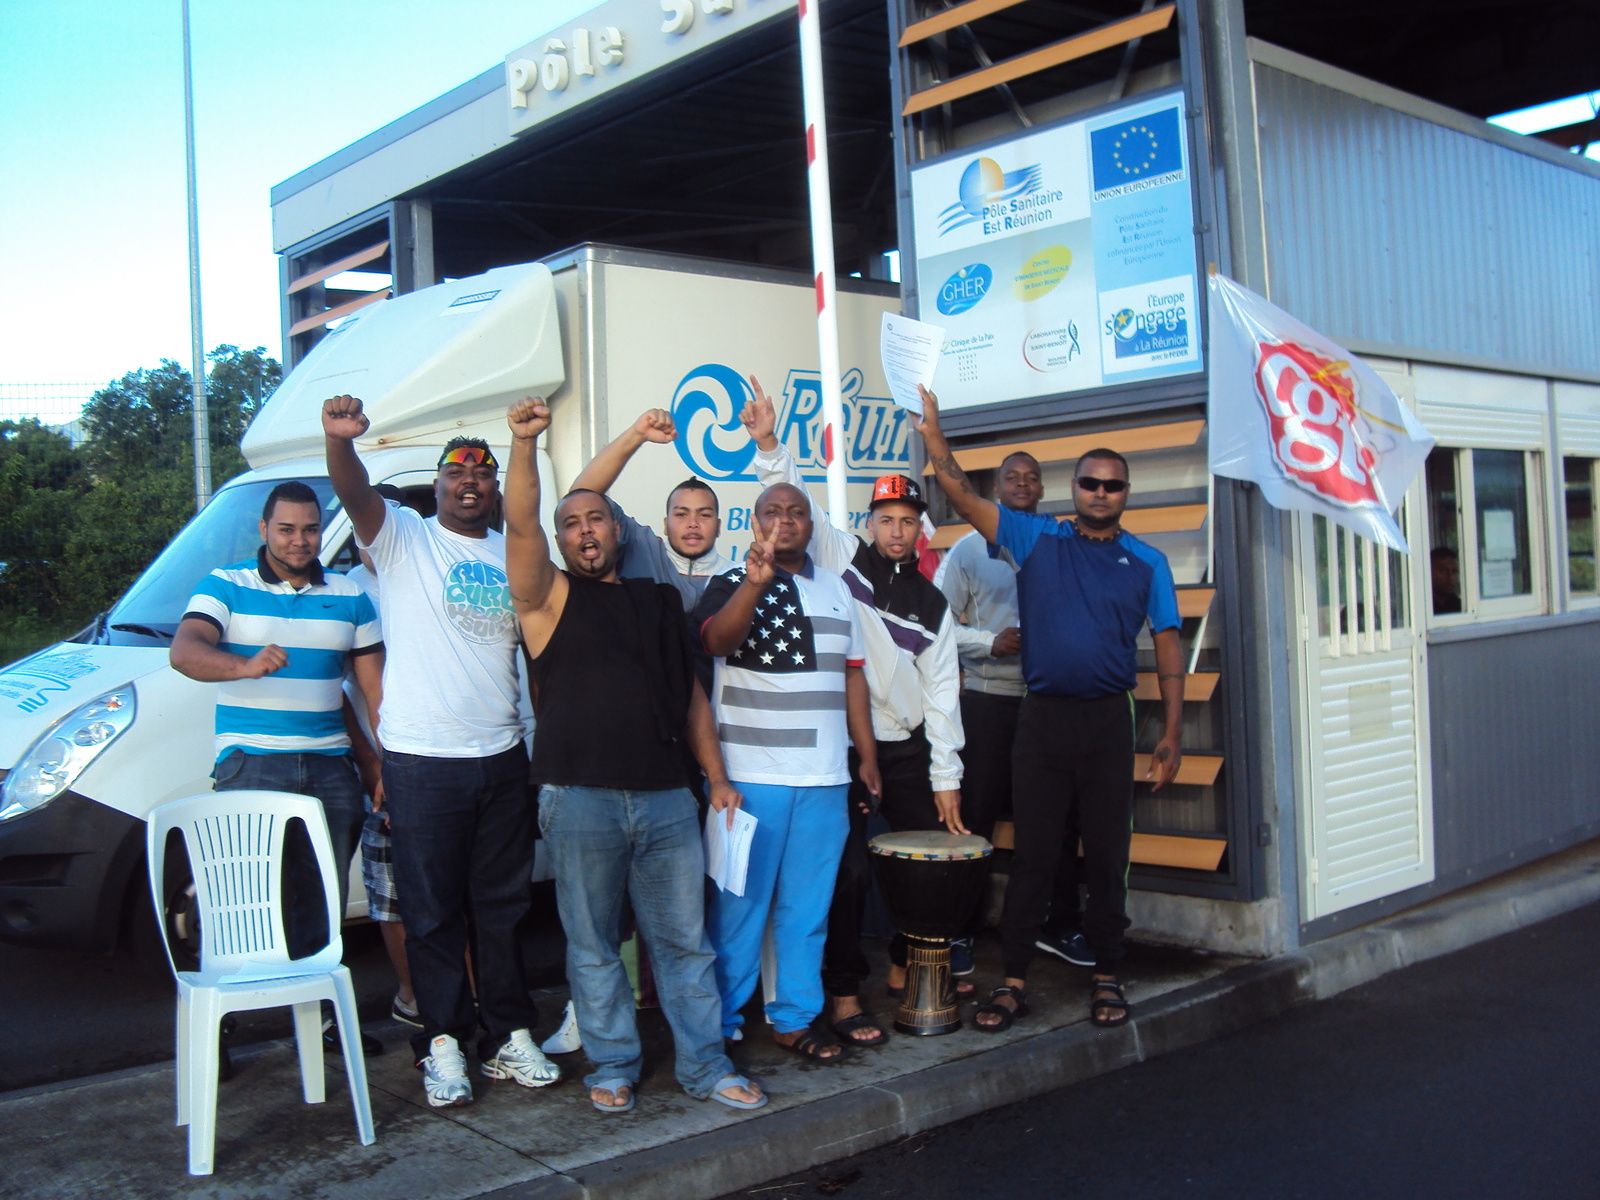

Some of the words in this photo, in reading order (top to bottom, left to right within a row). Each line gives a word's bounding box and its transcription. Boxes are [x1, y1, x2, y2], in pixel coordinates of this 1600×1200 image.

[510, 26, 625, 109] Pôle
[983, 203, 1008, 221] Pôle
[1010, 189, 1063, 213] Sanitaire
[1094, 188, 1122, 201] UNION
[983, 219, 1003, 236] Est
[1005, 208, 1053, 231] Réunion
[942, 276, 986, 302] GHER
[1147, 292, 1185, 308] l'Europe
[1140, 340, 1151, 352] La
[1152, 334, 1188, 350] Réunion
[449, 562, 508, 586] RIP
